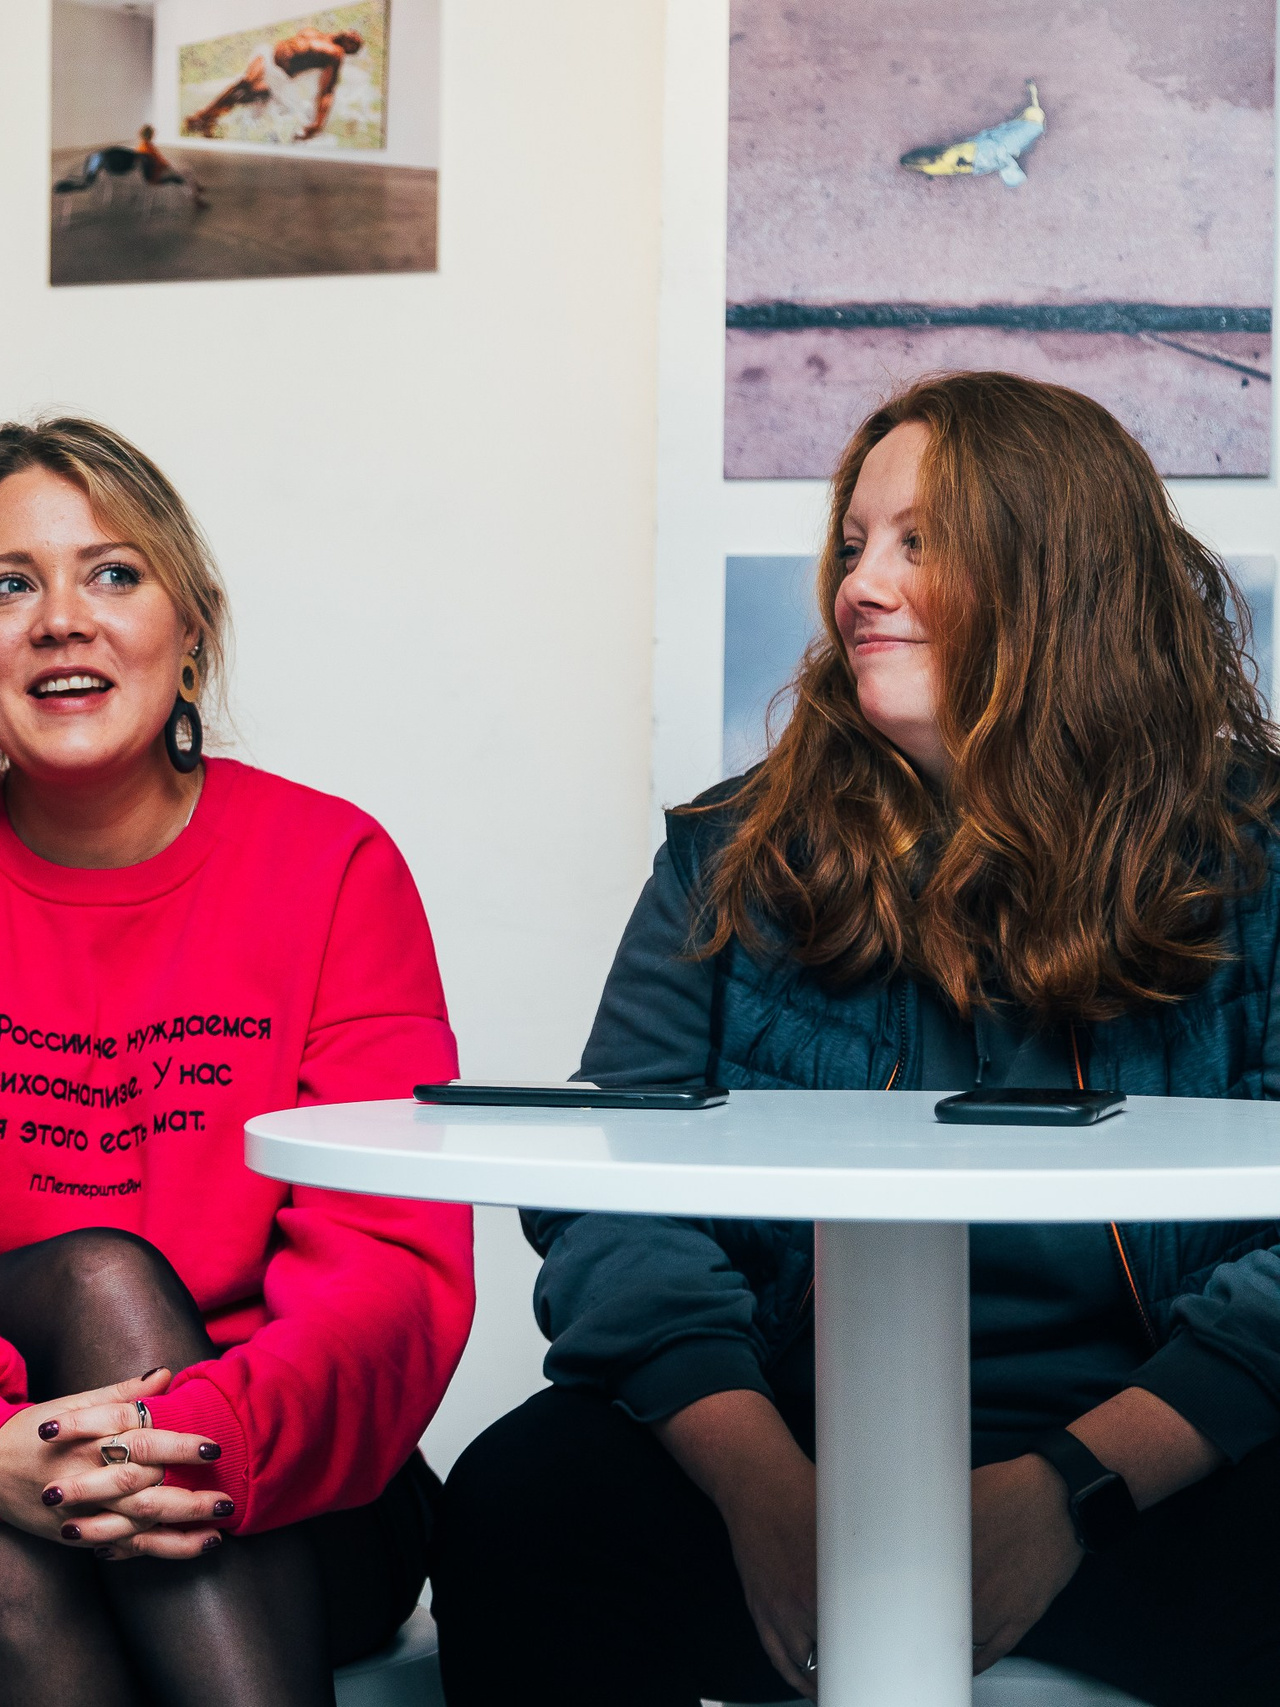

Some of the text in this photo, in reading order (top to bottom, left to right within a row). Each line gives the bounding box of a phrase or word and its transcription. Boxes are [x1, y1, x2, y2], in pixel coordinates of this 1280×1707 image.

[126, 1014, 272, 1053] нуждаемся
[152, 1057, 173, 1089] У
[179, 1062, 233, 1087] нас
[19, 1120, 89, 1152] этого
[99, 1122, 148, 1154] есть
[153, 1109, 206, 1135] мат.
